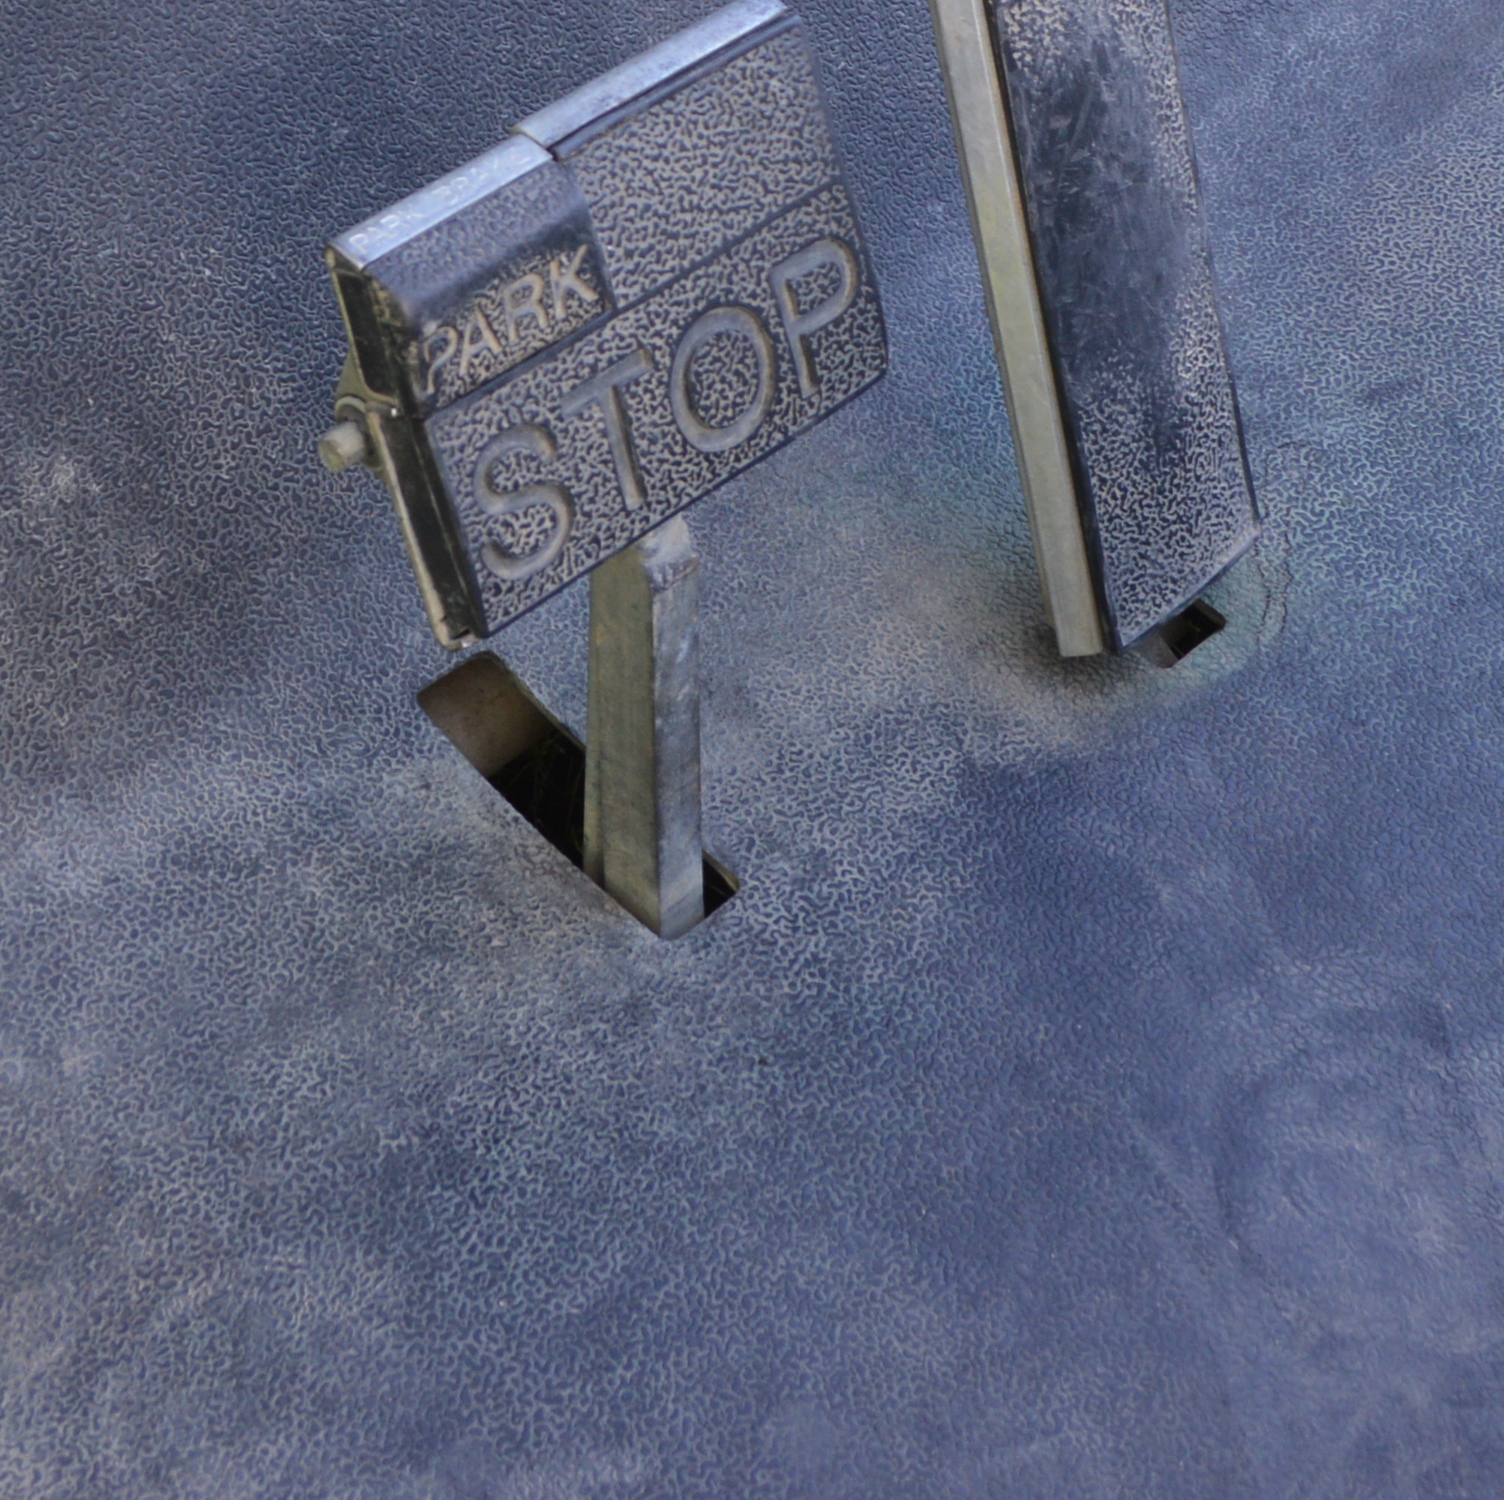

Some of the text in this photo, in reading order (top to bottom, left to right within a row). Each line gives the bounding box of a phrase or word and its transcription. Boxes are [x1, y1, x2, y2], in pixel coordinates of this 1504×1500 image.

[349, 203, 425, 255] PARK
[423, 244, 600, 375] PARK
[474, 238, 858, 579] STOP
